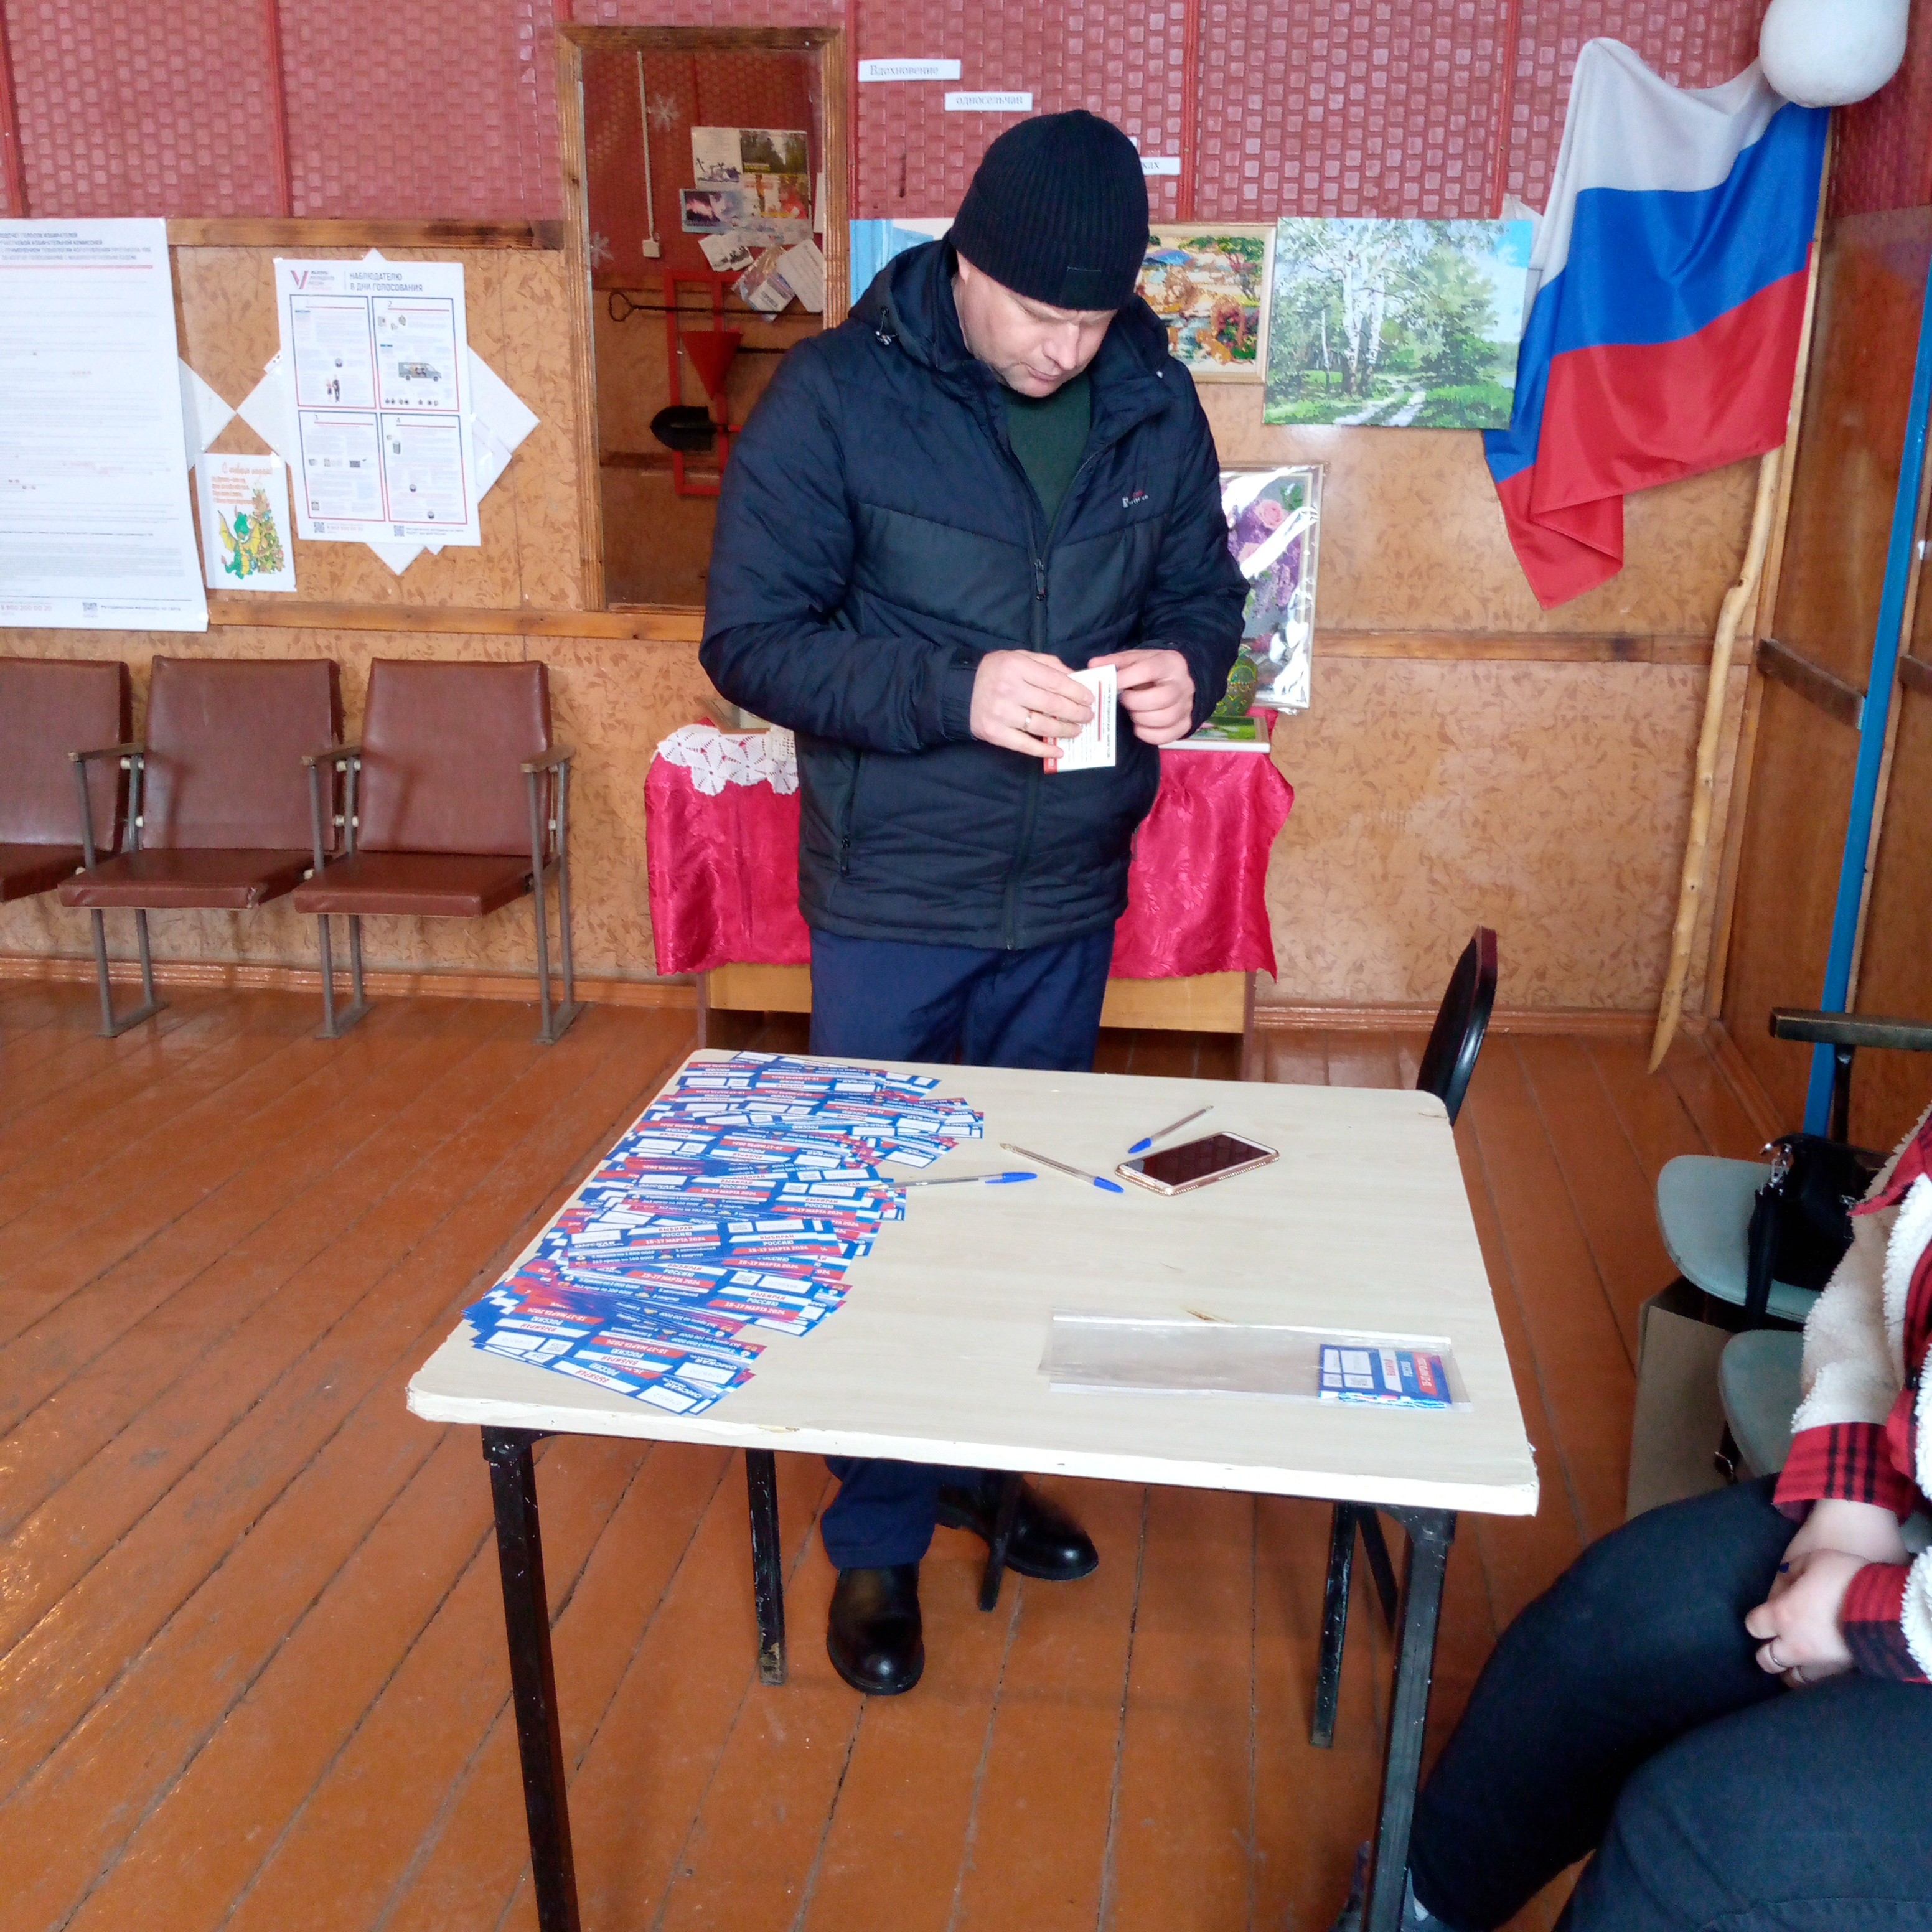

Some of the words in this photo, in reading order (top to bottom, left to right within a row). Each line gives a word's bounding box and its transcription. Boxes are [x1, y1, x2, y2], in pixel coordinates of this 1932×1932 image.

[870, 65, 938, 76] Вдохновение
[956, 96, 1023, 106] односельчан
[350, 273, 402, 281] НАБЛЮДАТЕЛЮ
[373, 284, 423, 292] ГОЛОСОВАНИЯ
[664, 1268, 695, 1277] РОССИЮ
[746, 1297, 779, 1306] РОССИЮ
[545, 1310, 568, 1319] МАРТА
[530, 1316, 564, 1325] РОССИЮ
[624, 1342, 649, 1351] МАРТА
[647, 1346, 670, 1354] 15-17
[611, 1348, 645, 1359] РОССИЮ
[589, 1363, 621, 1376] РОССИЮ
